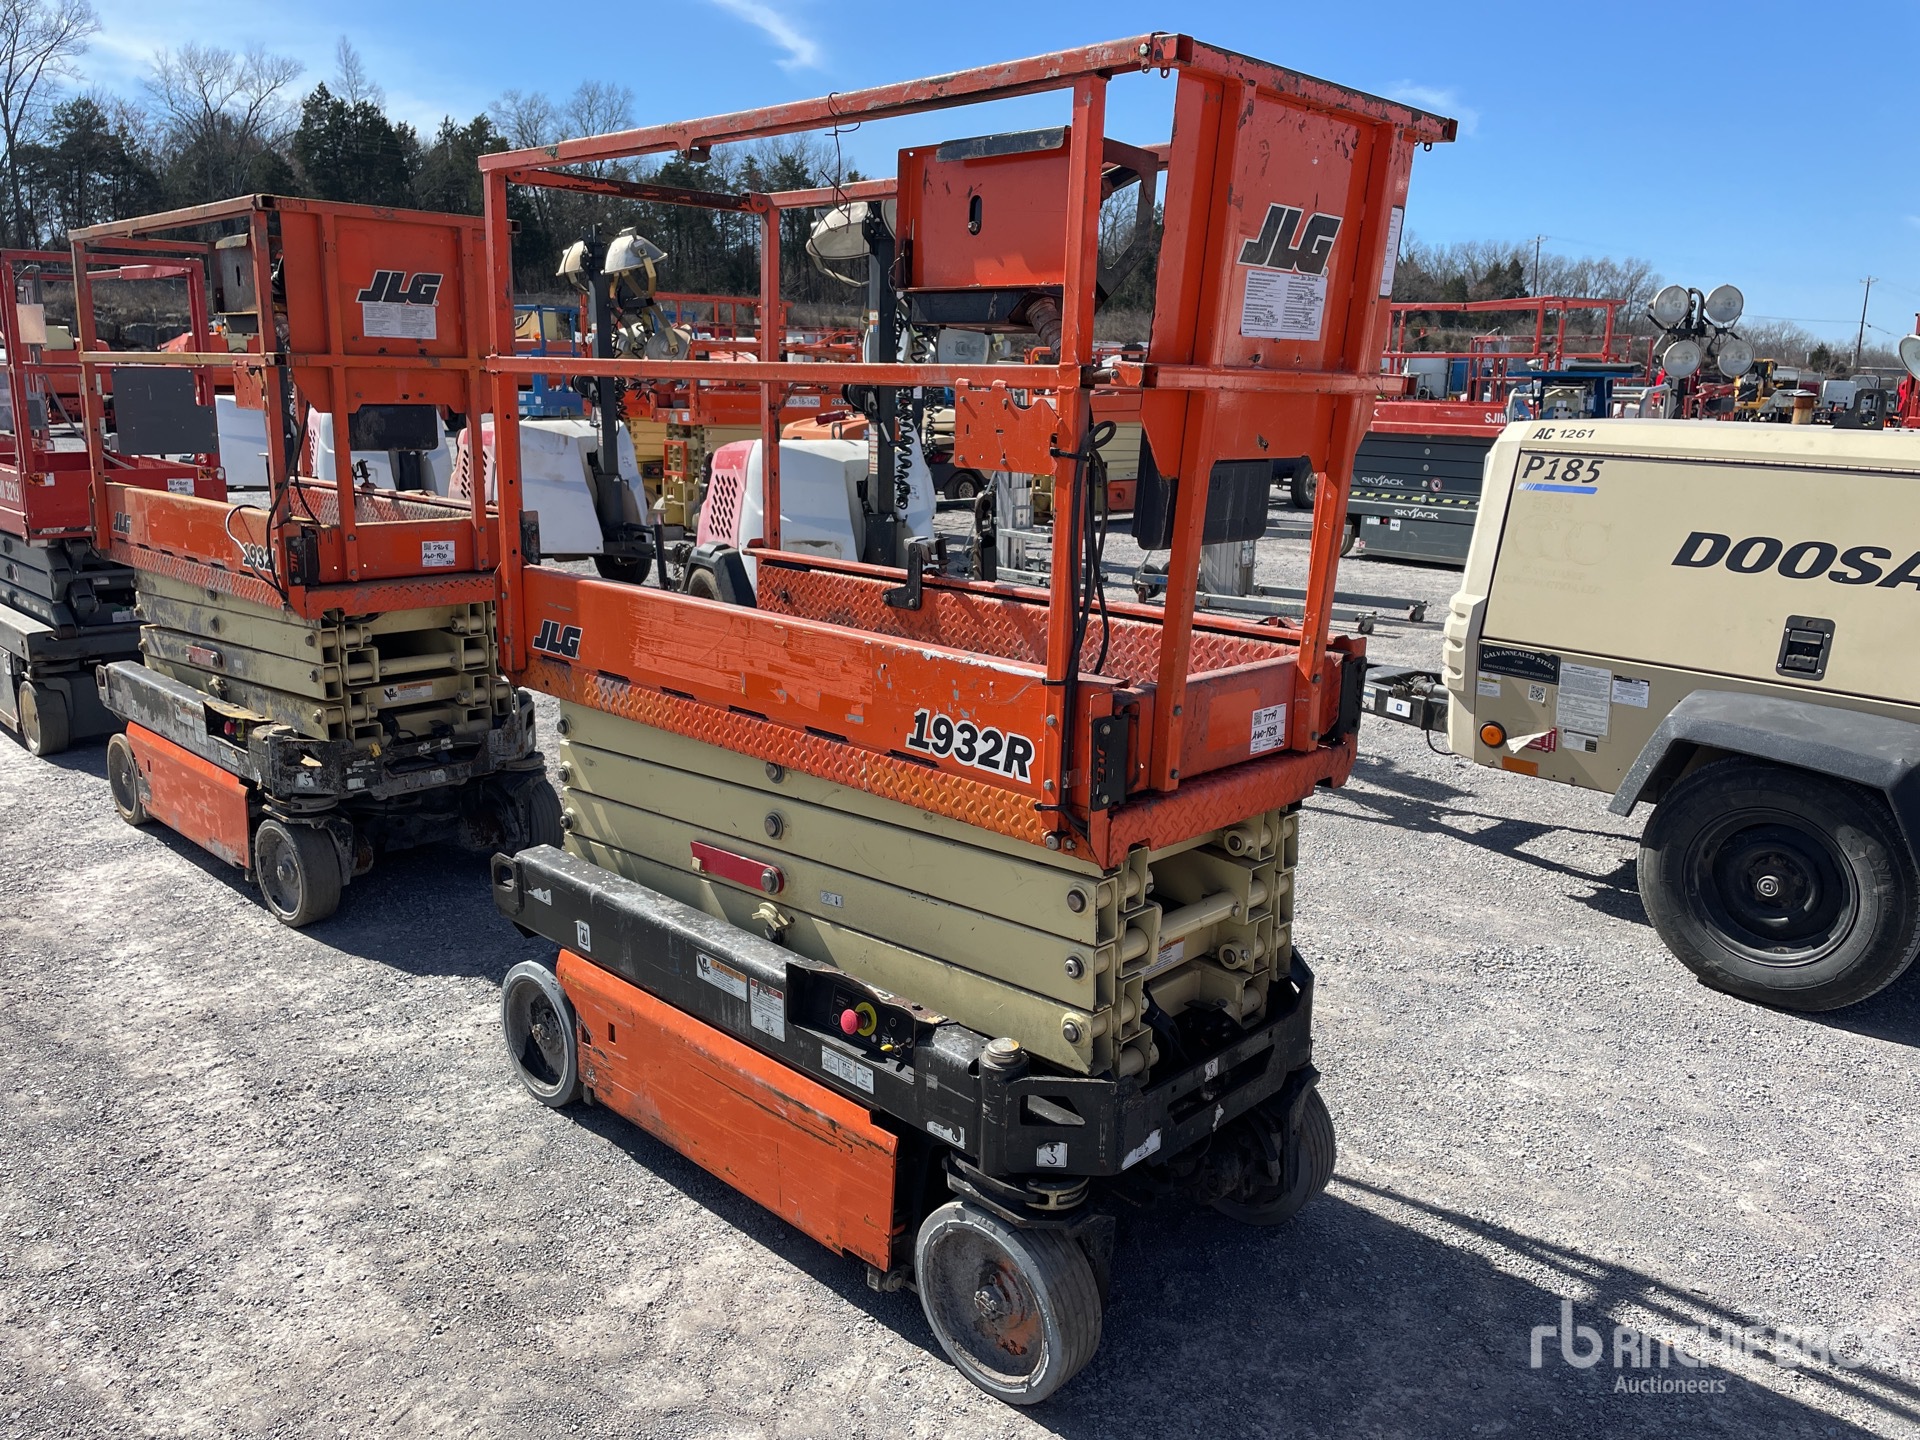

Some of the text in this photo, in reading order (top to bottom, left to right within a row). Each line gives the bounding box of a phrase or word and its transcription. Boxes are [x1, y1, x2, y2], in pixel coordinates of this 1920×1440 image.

[1237, 203, 1343, 276] JLG
[356, 269, 443, 305] JLG
[1532, 427, 1596, 440] AC 1261
[1361, 475, 1404, 486] SKYJACK
[1522, 456, 1605, 484] P185
[1394, 508, 1439, 519] SKYJACK
[532, 619, 583, 659] JLG
[1483, 650, 1556, 671] GALVANNEALED STEEL
[906, 708, 1036, 784] 1932R
